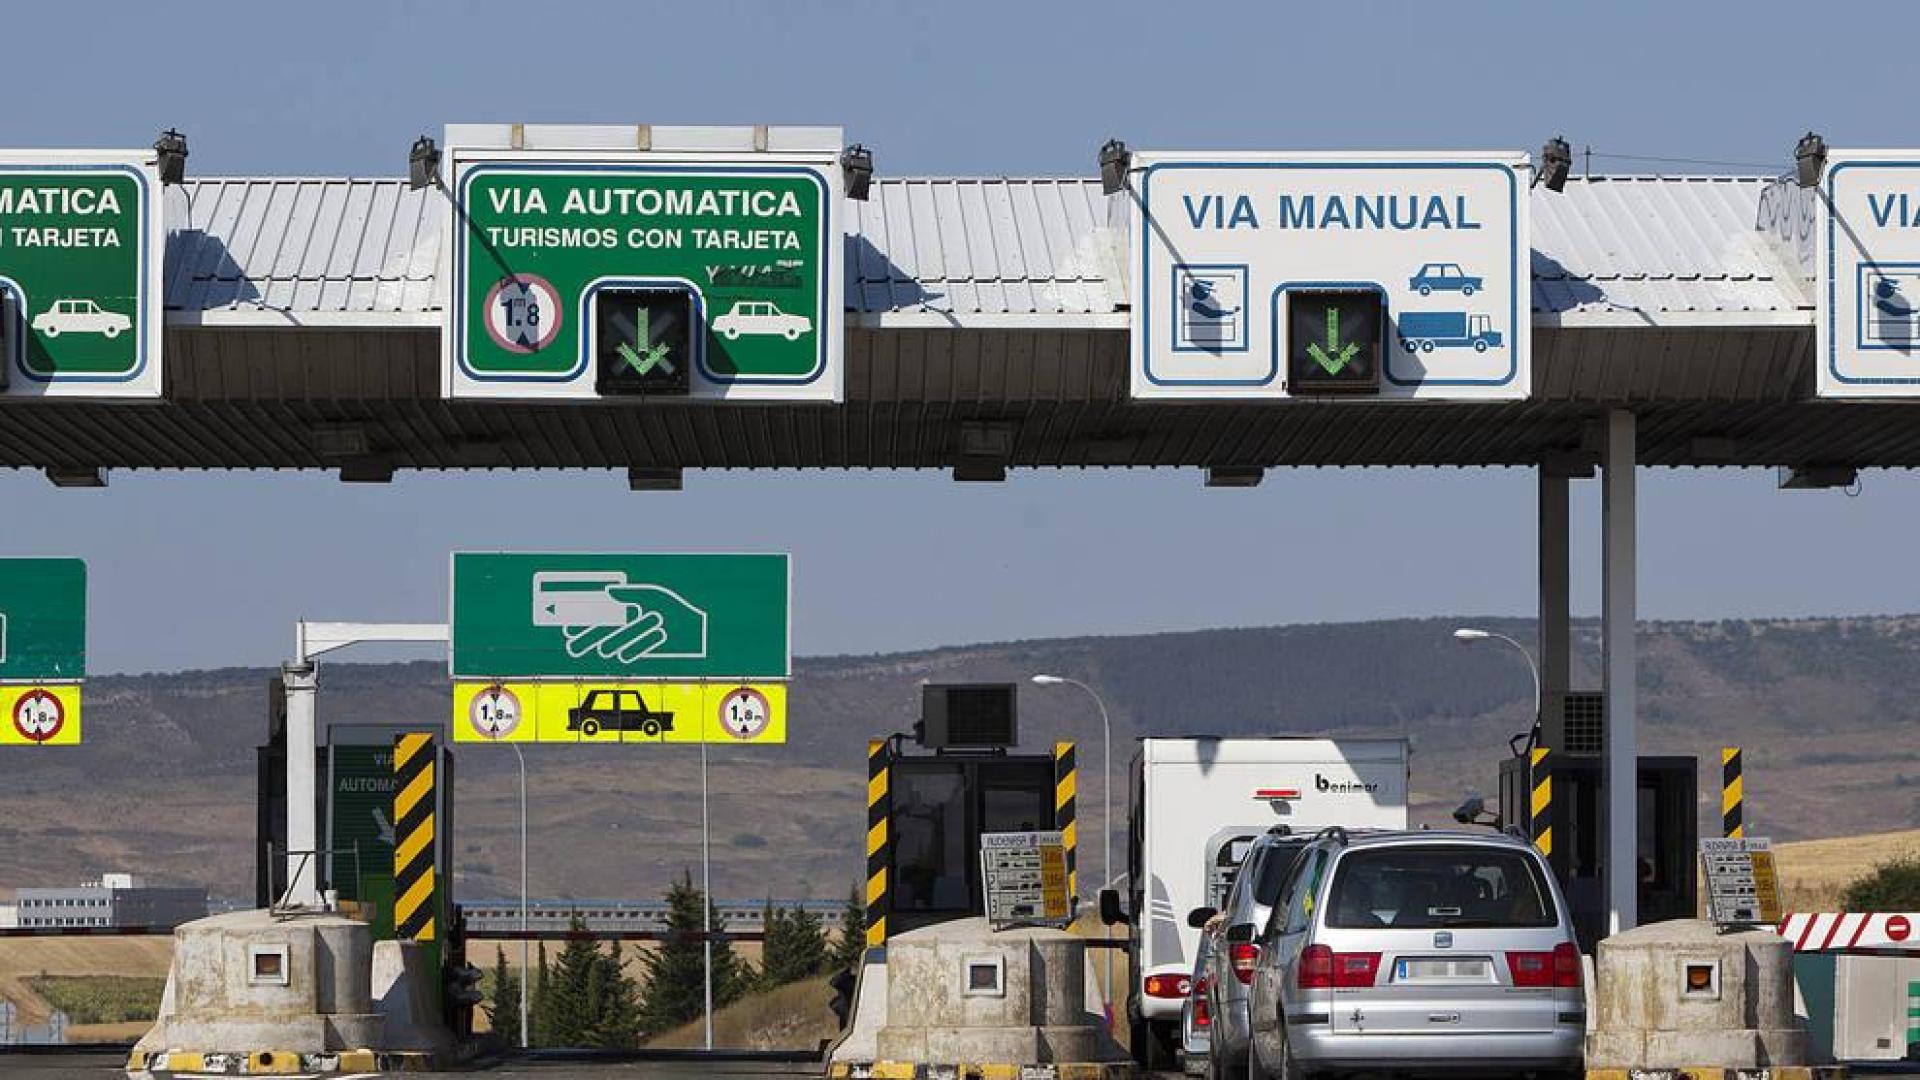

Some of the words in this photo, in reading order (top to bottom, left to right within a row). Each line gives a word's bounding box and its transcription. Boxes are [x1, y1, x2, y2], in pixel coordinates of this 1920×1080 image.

[488, 187, 548, 214] VIA
[562, 187, 802, 217] AUTOMATICA
[1183, 195, 1260, 230] VIA
[1279, 195, 1482, 230] MANUAL
[11, 228, 121, 248] TARJETA
[486, 226, 618, 248] TURISMOS
[627, 228, 682, 249] CON
[691, 228, 801, 250] TARJETA
[1315, 773, 1378, 793] benimar
